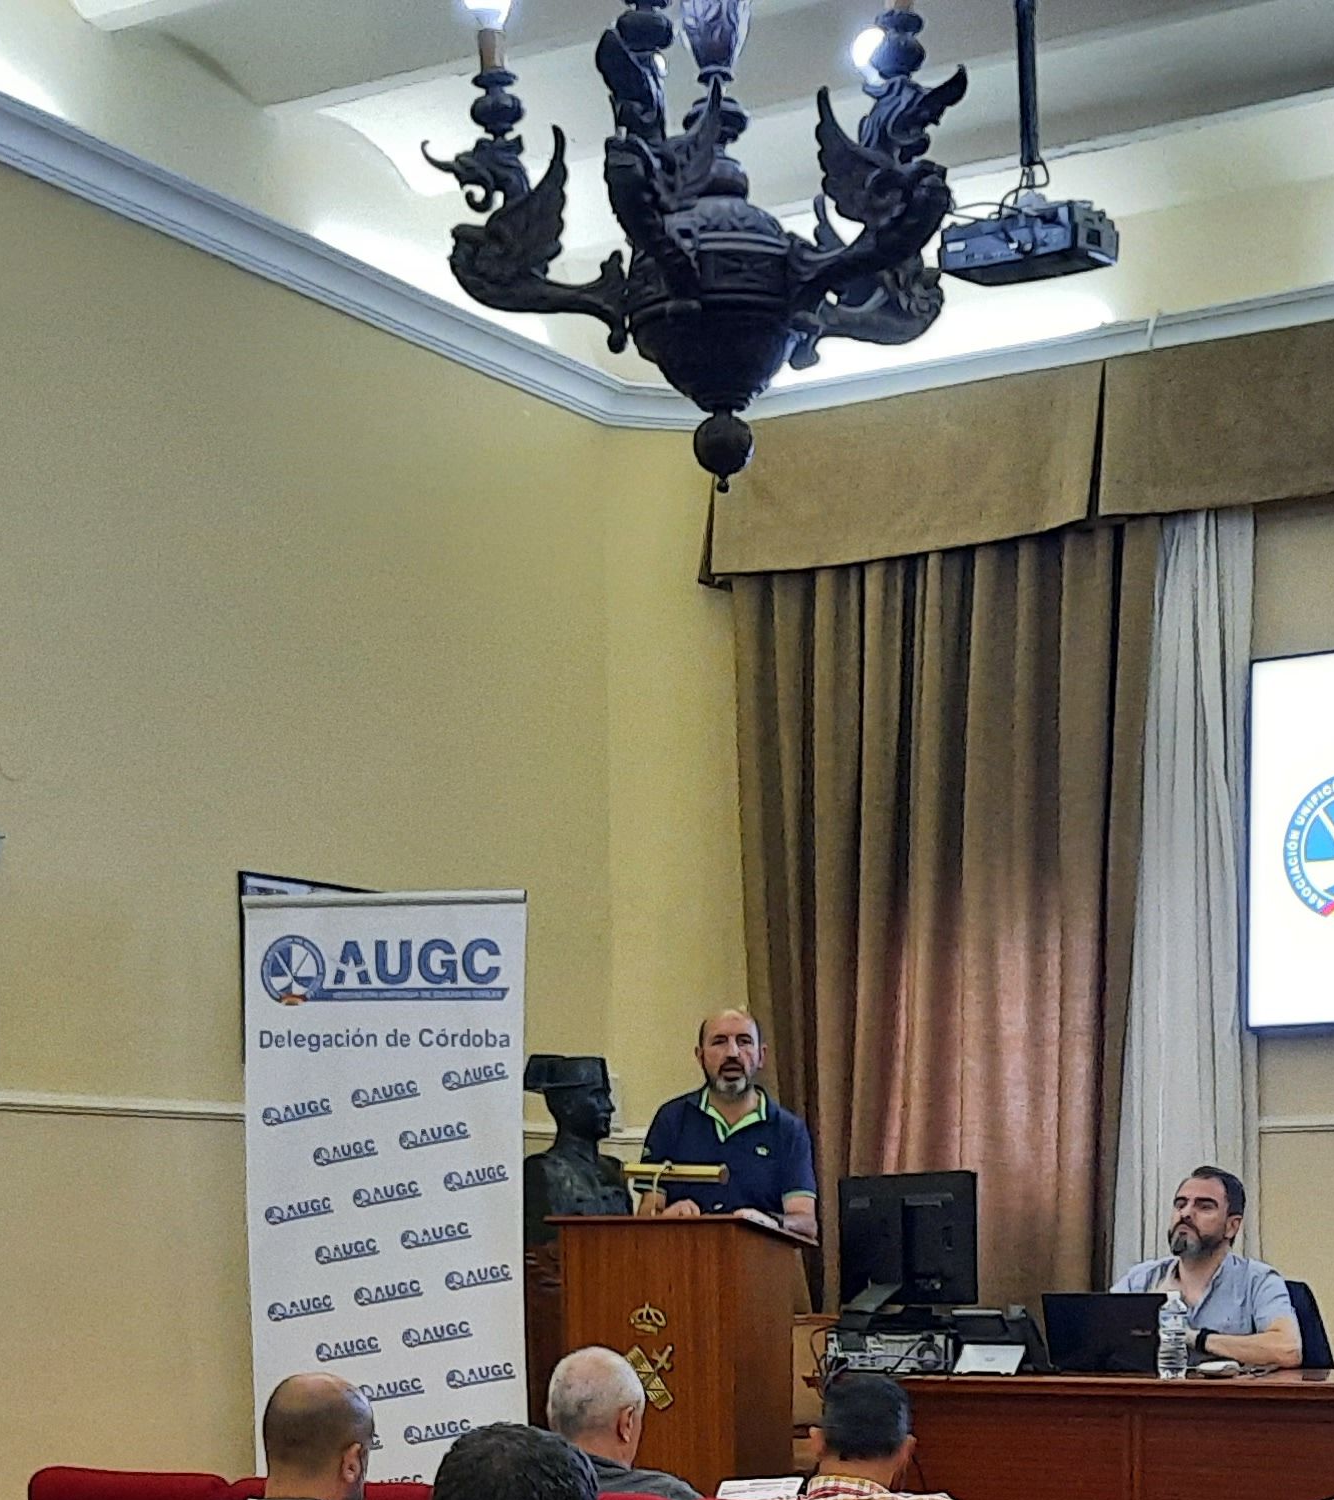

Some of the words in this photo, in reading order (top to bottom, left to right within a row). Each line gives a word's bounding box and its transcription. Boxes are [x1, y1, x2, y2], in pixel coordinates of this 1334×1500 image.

[334, 938, 502, 985] AUGC
[259, 1028, 378, 1053] Delegación
[386, 1029, 411, 1048] de
[418, 1028, 511, 1048] Córdoba
